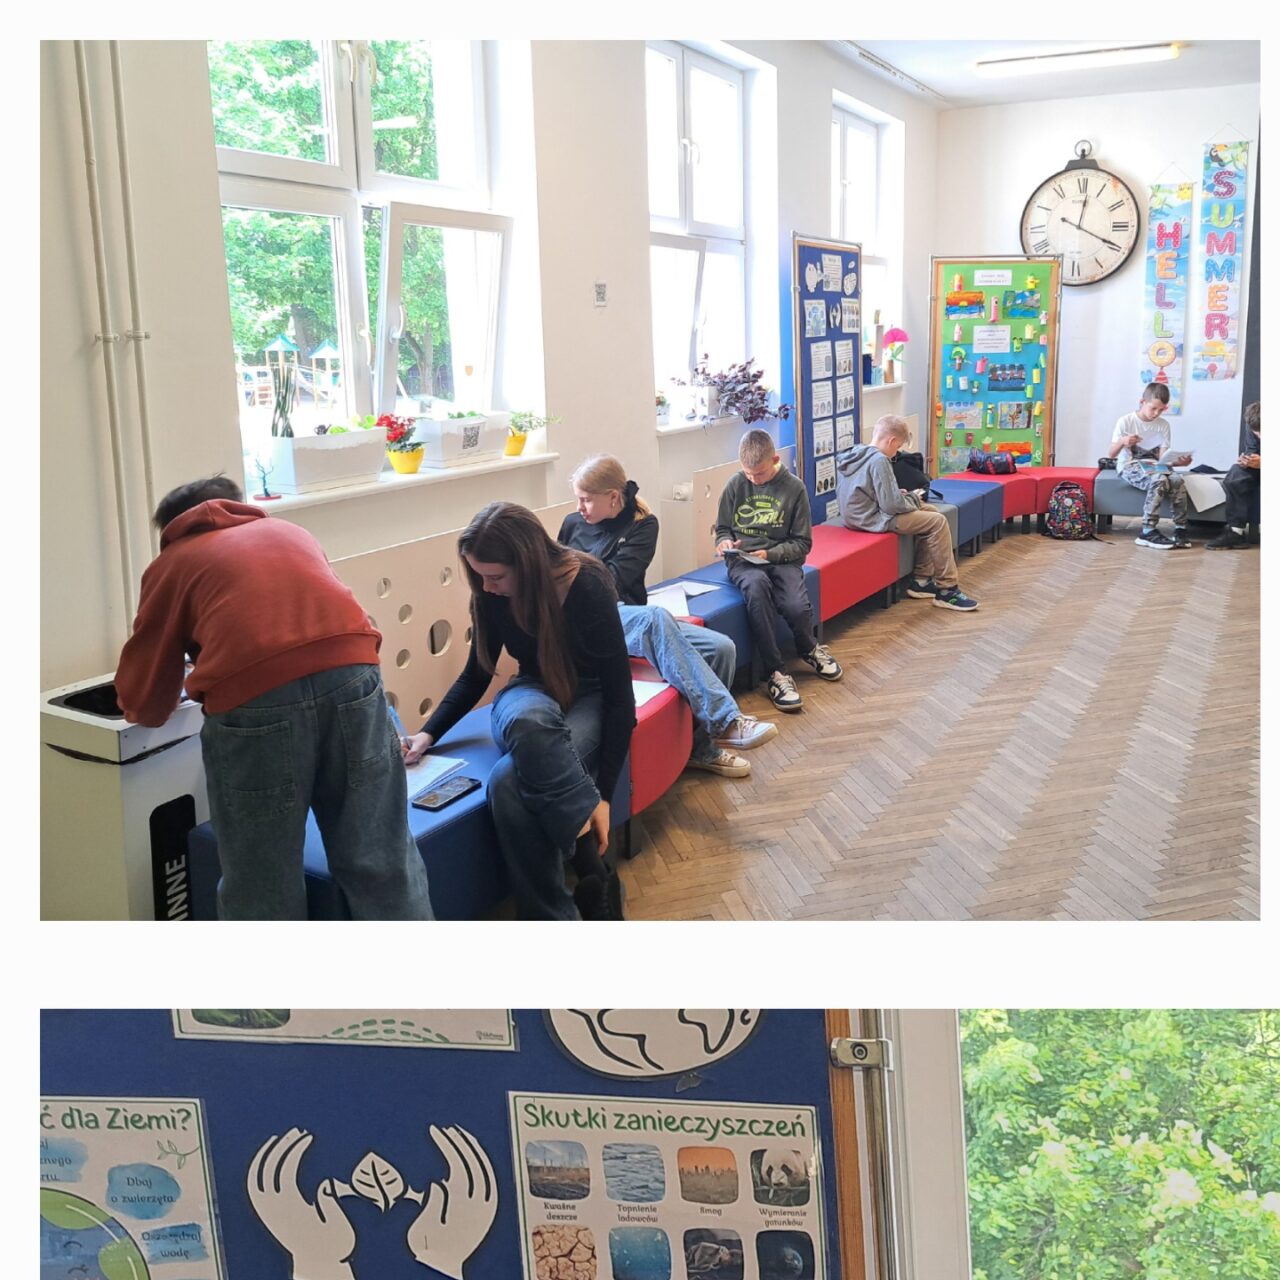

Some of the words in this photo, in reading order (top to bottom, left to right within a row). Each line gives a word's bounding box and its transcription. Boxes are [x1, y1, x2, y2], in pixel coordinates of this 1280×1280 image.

[1204, 170, 1237, 340] SUMMER
[1149, 222, 1183, 367] HELLO
[61, 1106, 100, 1130] dla
[105, 1107, 192, 1131] Ziemi?
[523, 1102, 607, 1129] Skutki
[613, 1110, 806, 1142] zanieczyszczeń
[617, 1204, 657, 1215] Topnienie
[700, 1207, 722, 1217] Smog
[759, 1208, 807, 1218] Wymieranie
